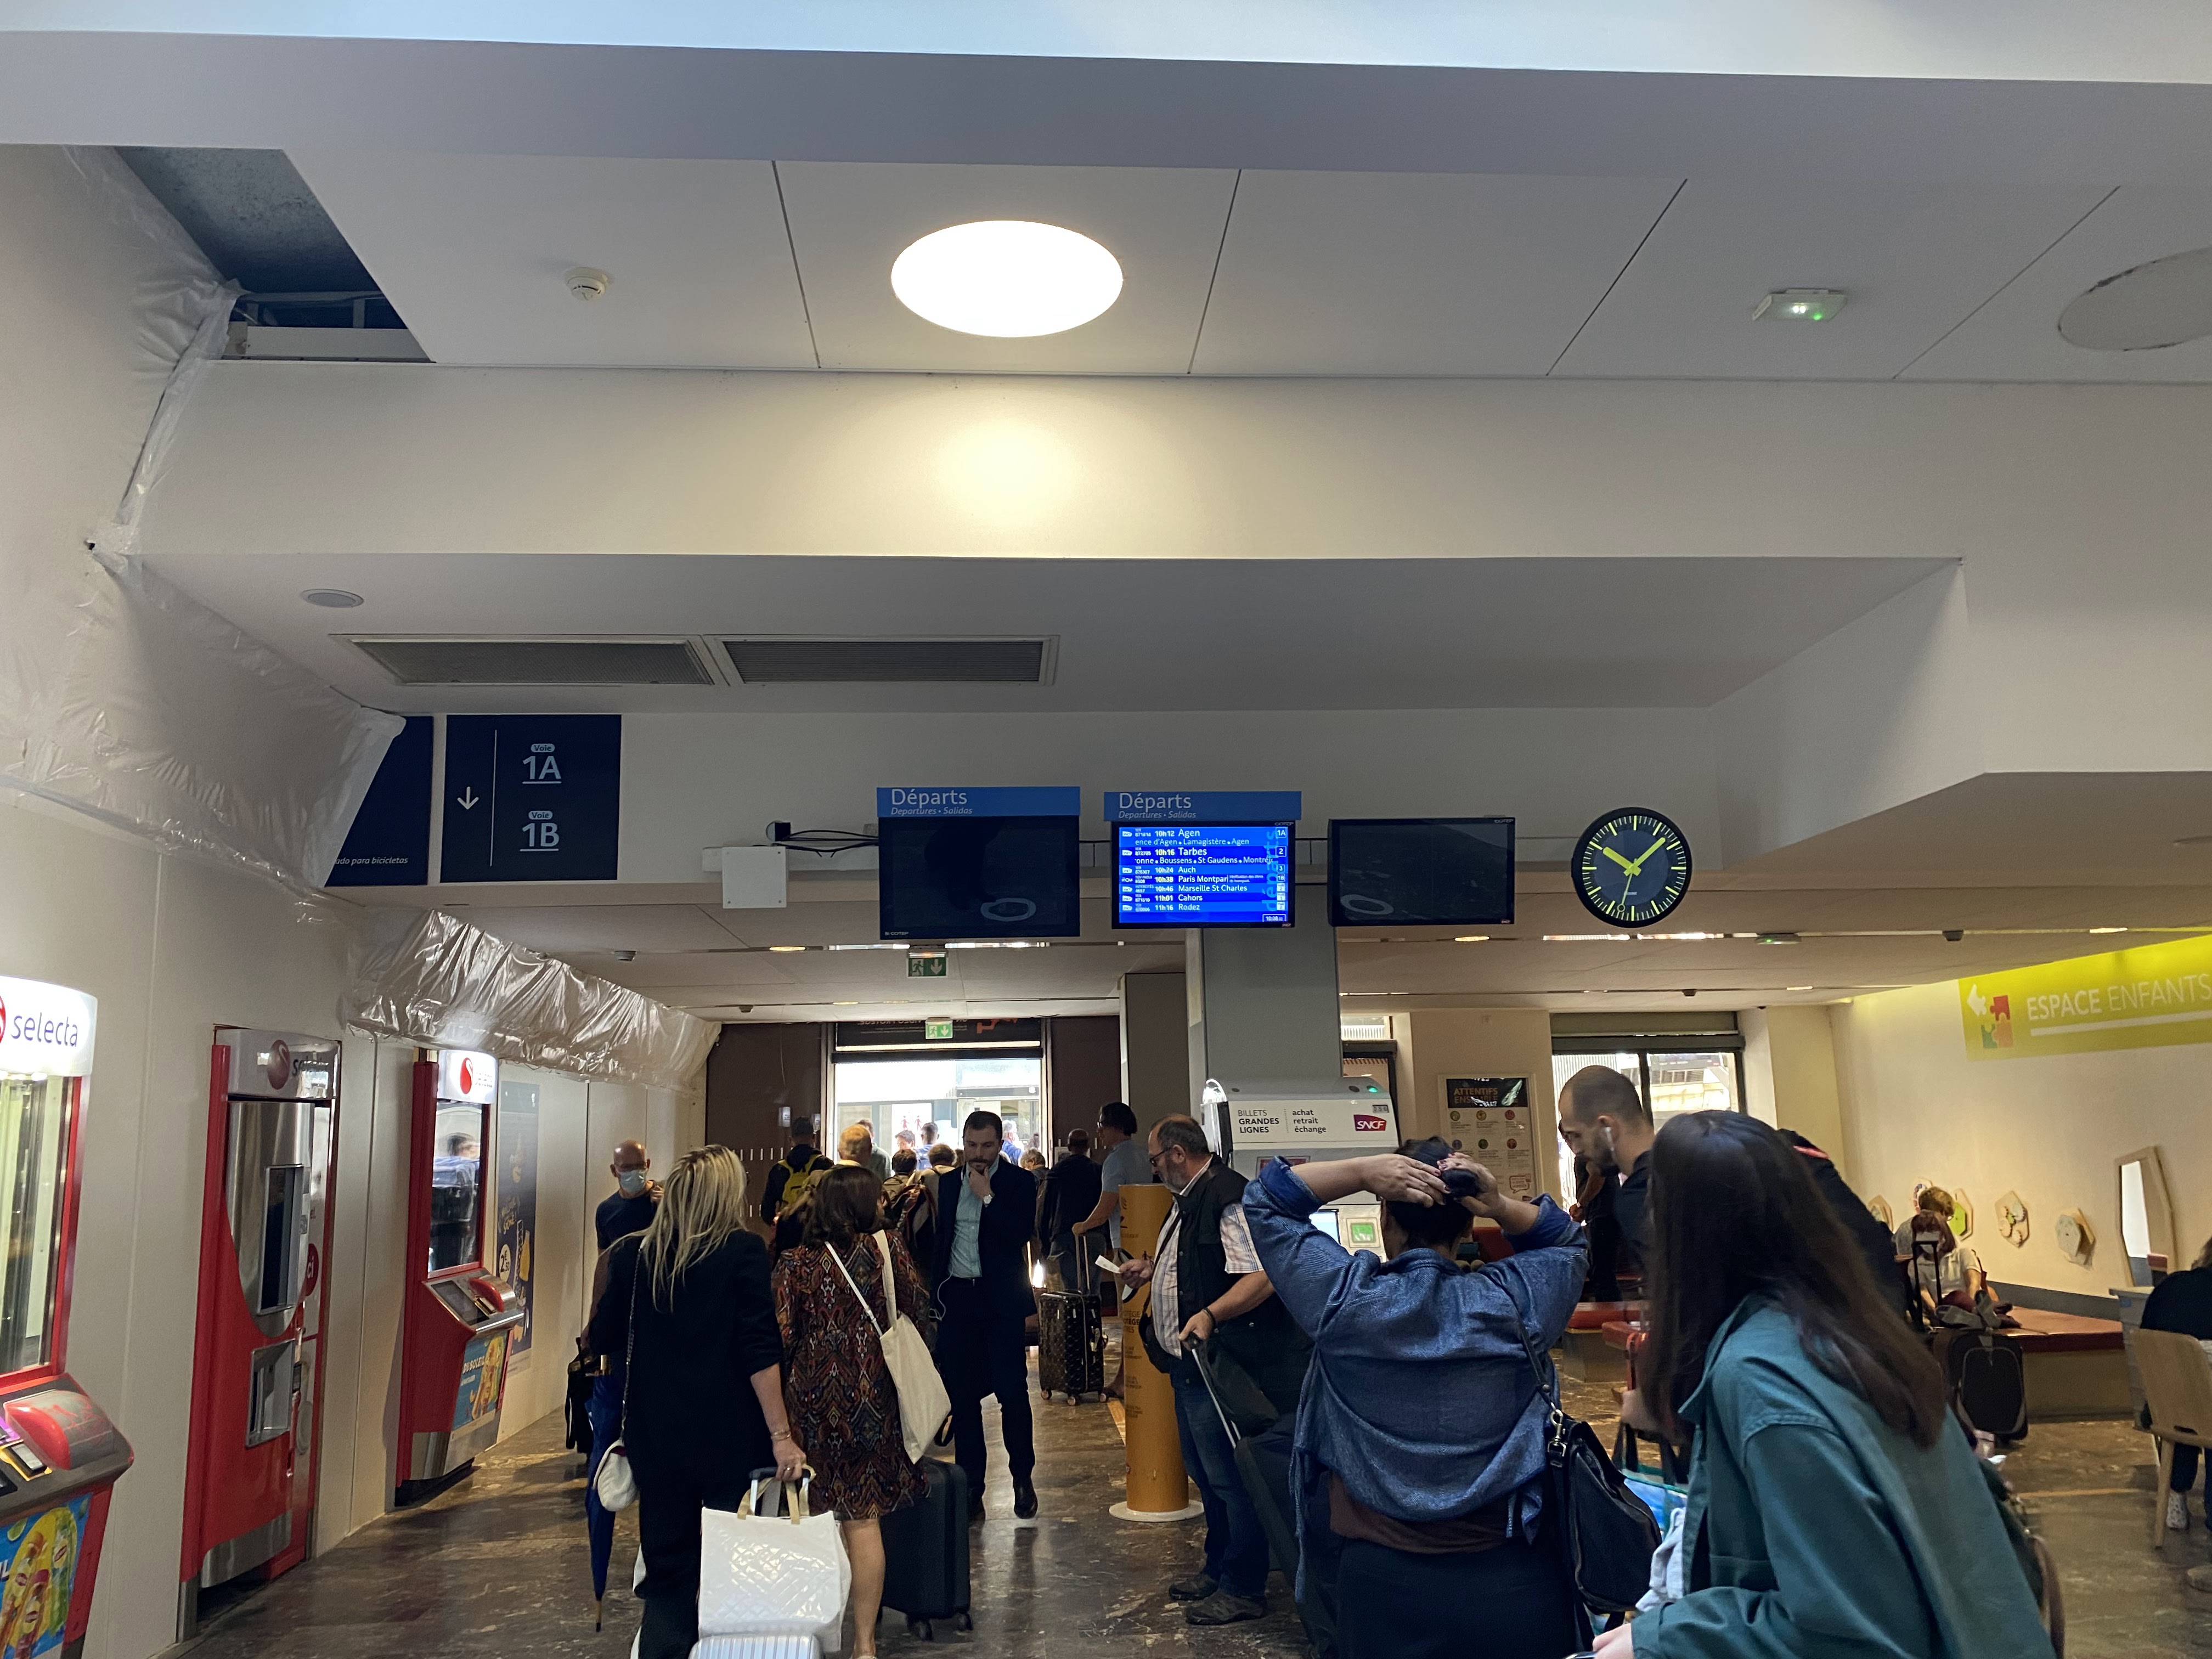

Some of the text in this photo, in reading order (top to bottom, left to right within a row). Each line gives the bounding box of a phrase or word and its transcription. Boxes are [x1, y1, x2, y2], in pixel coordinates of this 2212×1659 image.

[533, 744, 552, 752] Voie
[522, 755, 562, 780] 1A
[891, 788, 968, 809] Départs
[1119, 792, 1192, 812] Départs
[531, 811, 550, 819] Voie
[890, 806, 973, 815] Departures Salidas
[1118, 811, 1162, 820] Departures
[522, 823, 560, 847] 1B
[1178, 828, 1200, 839] Agen
[1154, 838, 1177, 847] d'Agen
[1183, 838, 1226, 847] Lamagistère
[1231, 838, 1249, 847] Agen
[1178, 847, 1207, 856] Tarbes
[351, 858, 370, 866] para
[2027, 973, 2212, 1021] ESPACE ENFANTS
[10, 1012, 78, 1047] selecta
[1453, 1087, 1498, 1096] ATTENTIFS
[1294, 1125, 1327, 1134] échange
[1357, 1120, 1385, 1130] SNCF
